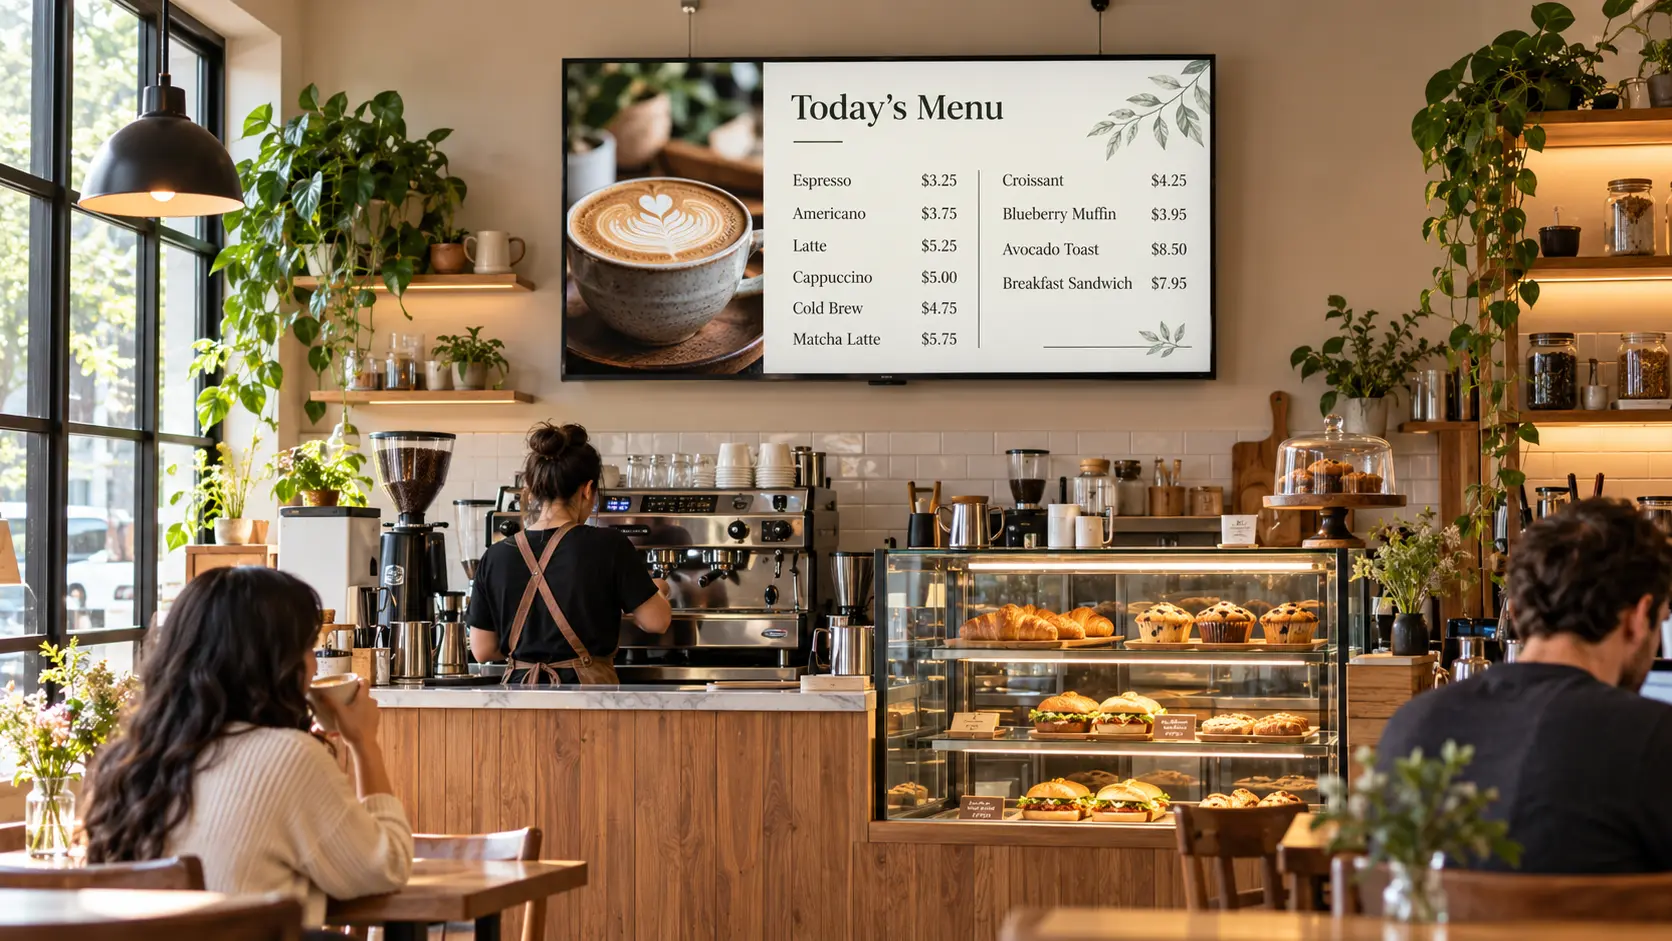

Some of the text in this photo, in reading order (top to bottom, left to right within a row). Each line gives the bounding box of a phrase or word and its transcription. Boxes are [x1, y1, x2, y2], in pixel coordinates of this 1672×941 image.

[791, 93, 1003, 127] Today’s Menu
[794, 174, 957, 190] Espresso $3.25
[1003, 174, 1186, 188] Croissant $4.25
[793, 207, 957, 220] Americano $3.75
[1004, 207, 1186, 223] Blueberry Muffin $3.95
[794, 239, 957, 252] Latte $5.25
[1003, 242, 1187, 256] Avocado Toast $8.50
[793, 270, 957, 287] Cappuccino $5.00
[1003, 276, 1187, 290] Breakfast Sandwich $7.95
[793, 301, 957, 315] Cold Brew $4.75
[793, 332, 957, 346] Matcha Latte $5.75
